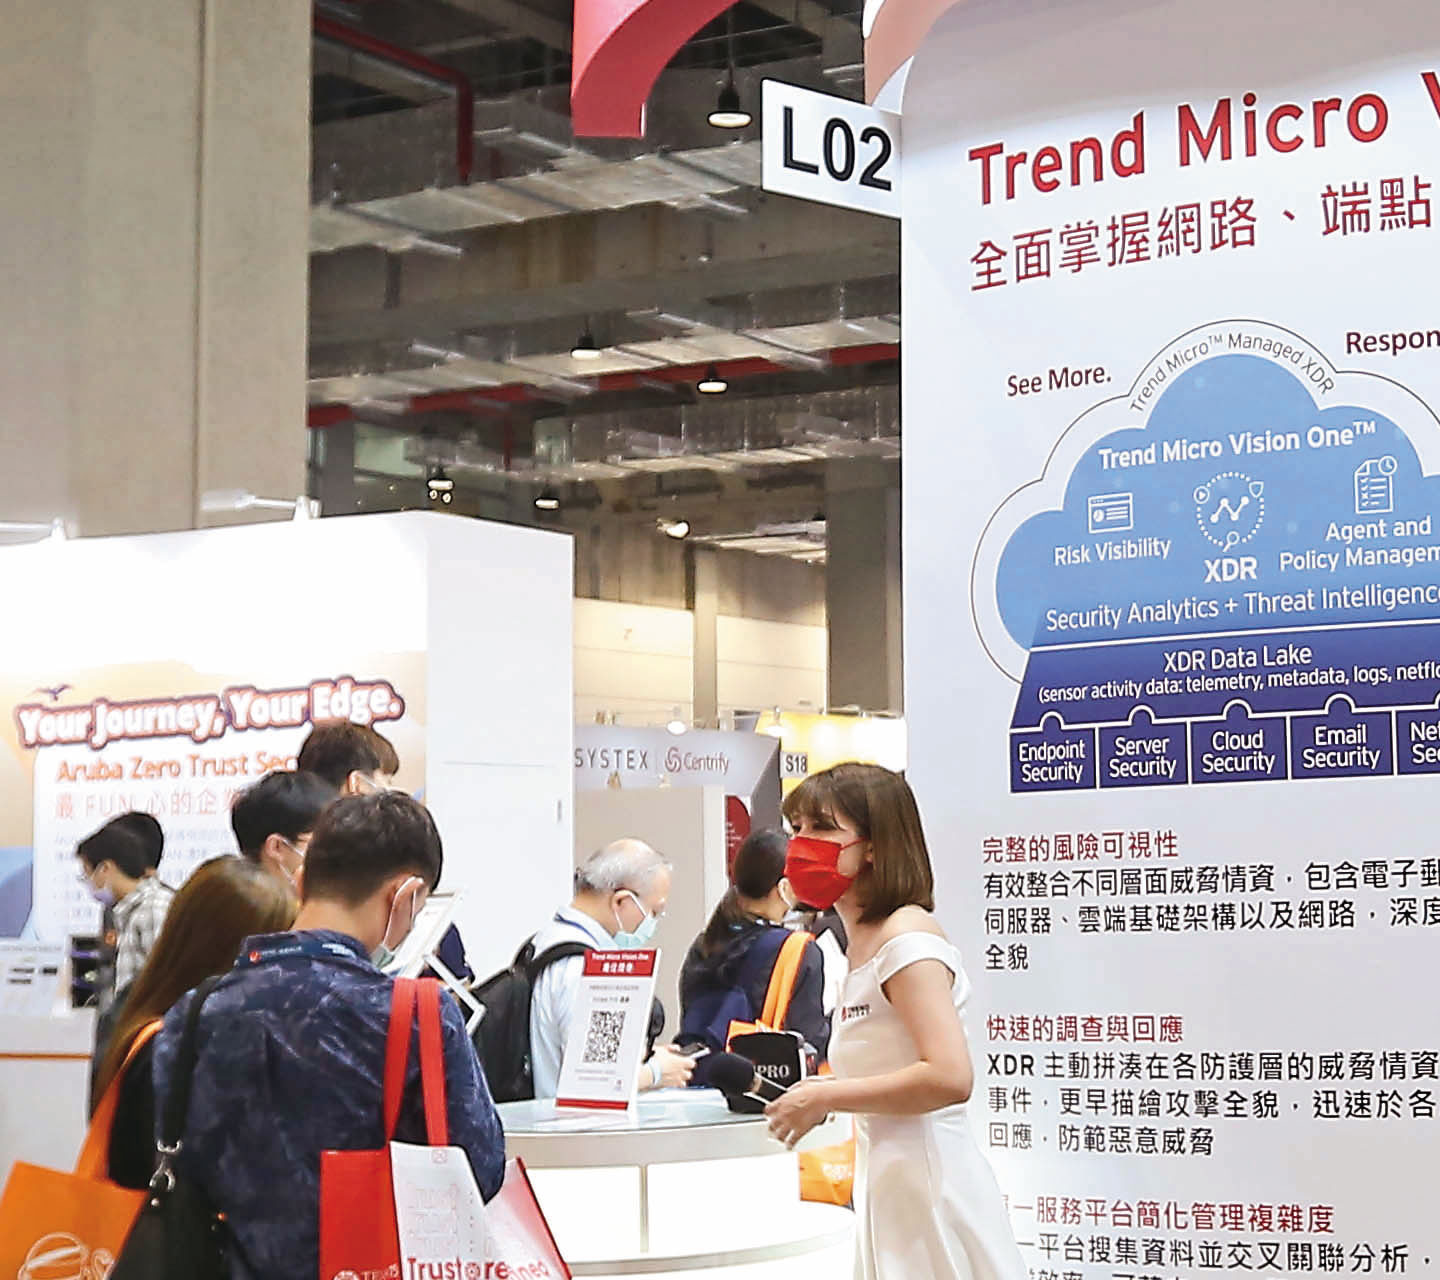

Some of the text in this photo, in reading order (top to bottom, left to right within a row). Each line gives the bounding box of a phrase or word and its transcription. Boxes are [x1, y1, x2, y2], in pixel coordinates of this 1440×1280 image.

[779, 102, 894, 191] L02
[969, 112, 1145, 206] Trend
[1176, 94, 1383, 169] Micro
[1007, 365, 1111, 397] See More.
[1130, 367, 1167, 413] Trend
[1228, 333, 1304, 364] Managed
[1301, 357, 1334, 395] XDR
[1099, 446, 1156, 470] Trend
[1163, 438, 1222, 463] Micro
[1229, 429, 1300, 456] Vision
[1325, 517, 1431, 545] Agent and
[1054, 538, 1171, 565] Risk Visibility
[1279, 547, 1338, 574] Policy
[1204, 558, 1257, 582] XDR
[1046, 604, 1122, 633] Security
[1127, 595, 1219, 627] Analytics
[1244, 589, 1315, 615] Threat
[1163, 644, 1312, 671] XDR Data Lake
[1039, 683, 1086, 704] (sensor
[1091, 679, 1141, 702] activity
[1146, 677, 1183, 697] data:
[1186, 671, 1263, 696] telemetry,
[1267, 667, 1347, 690] metadata,
[1353, 665, 1391, 688] logs,
[16, 676, 405, 749] Your Journey, Your Edge.
[1115, 735, 1169, 757] Server
[1212, 730, 1263, 751] Cloud
[1314, 726, 1366, 746] Email
[575, 748, 648, 769] SYSTEX
[684, 752, 729, 775] Centrify
[785, 753, 808, 772] S18
[1019, 740, 1085, 764] Endpoint
[1202, 749, 1275, 775] Security
[1302, 744, 1380, 770] Security
[58, 760, 123, 782] Aruba
[132, 757, 181, 779] Zero
[190, 754, 248, 776] Trust
[1021, 761, 1082, 784] Security
[1109, 755, 1176, 779] Security
[983, 831, 1179, 862] 完整的風險可視性
[986, 944, 1028, 971] 全貌
[987, 1016, 1184, 1044] 快速的調查與回應
[988, 1054, 1034, 1077] XDR
[407, 1257, 462, 1280] Trust
